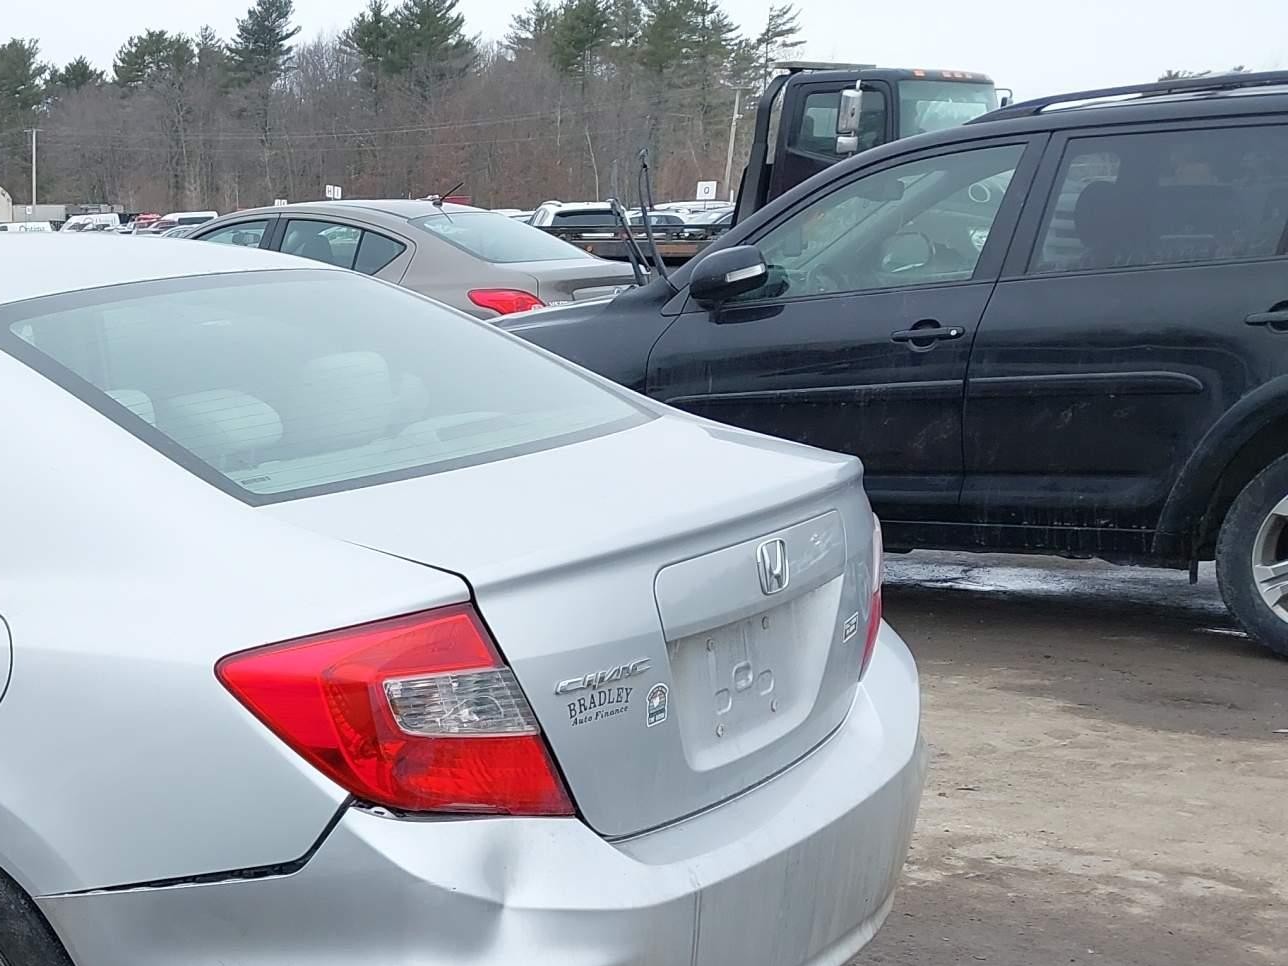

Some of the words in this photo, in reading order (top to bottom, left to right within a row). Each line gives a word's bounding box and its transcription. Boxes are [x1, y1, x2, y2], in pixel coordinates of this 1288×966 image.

[567, 687, 633, 719] BRADLEY
[571, 715, 592, 727] Auto
[595, 705, 629, 720] Finance
